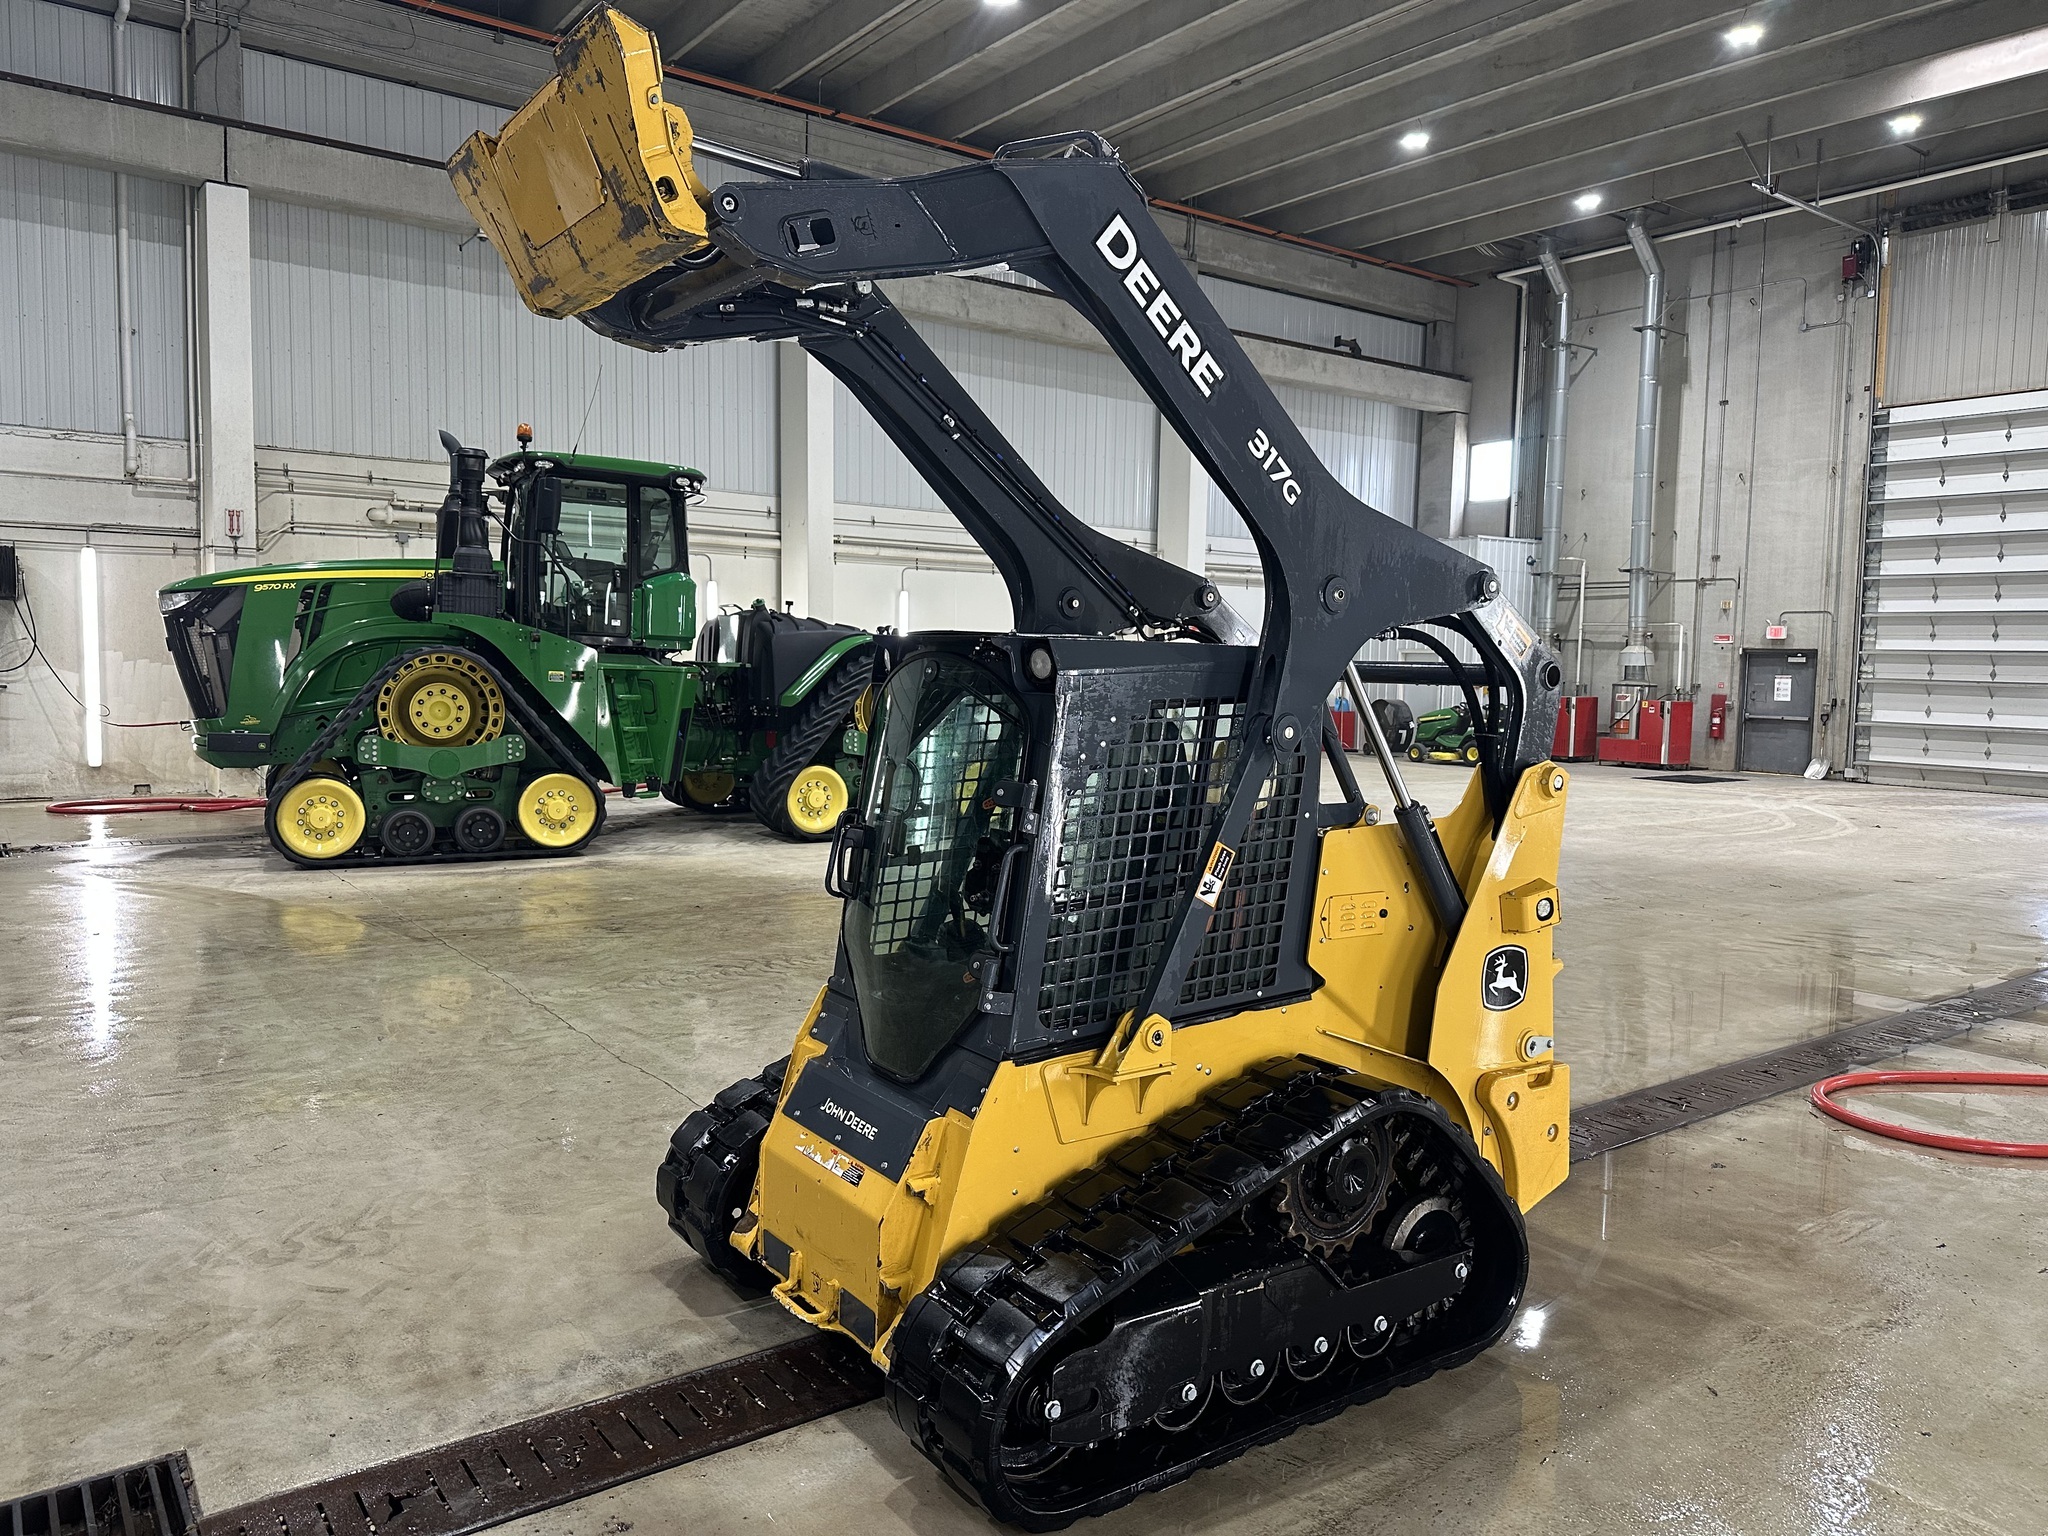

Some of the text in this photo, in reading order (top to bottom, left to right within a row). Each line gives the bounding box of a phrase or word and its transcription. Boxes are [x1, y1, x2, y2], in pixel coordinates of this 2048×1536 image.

[1095, 213, 1225, 399] DEERE
[1246, 427, 1302, 506] 317G
[254, 582, 297, 592] 9570 RX
[820, 1097, 879, 1141] JOHN DEERE
